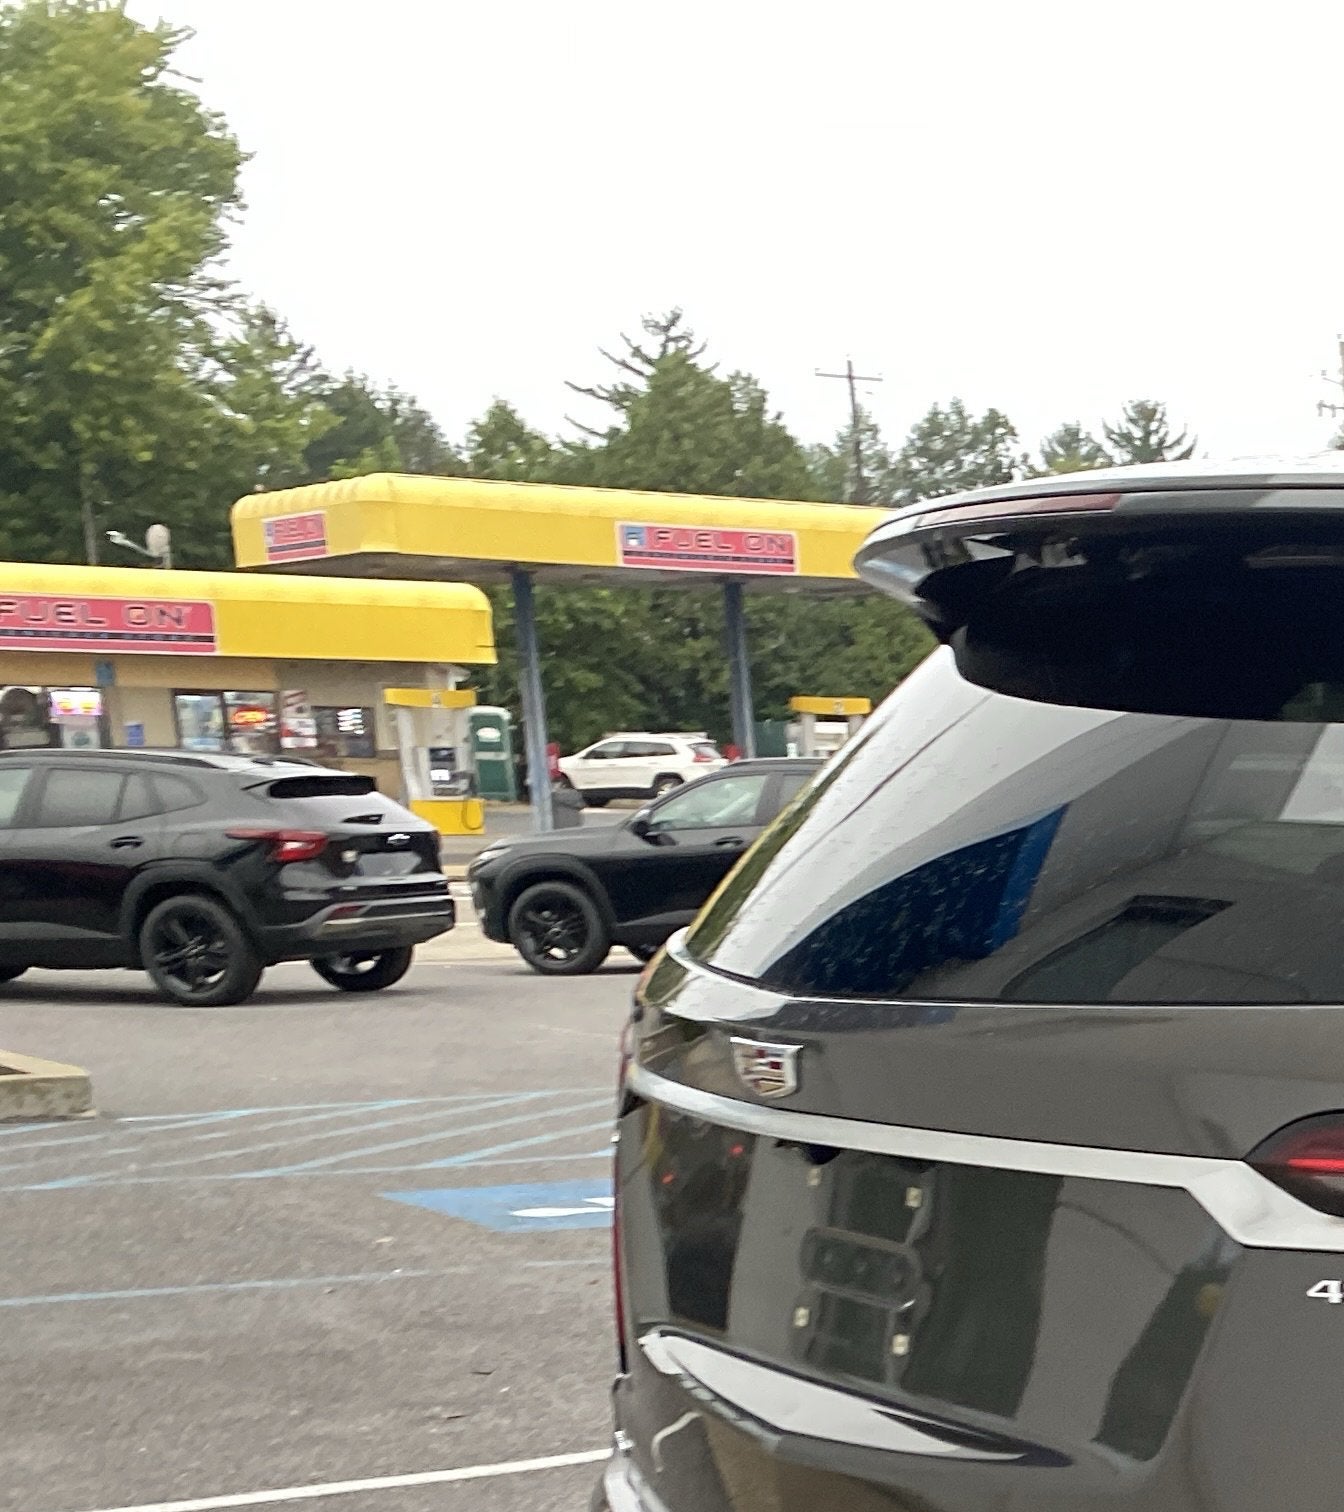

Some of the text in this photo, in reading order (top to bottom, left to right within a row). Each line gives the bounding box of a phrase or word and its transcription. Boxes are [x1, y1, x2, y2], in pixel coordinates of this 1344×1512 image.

[654, 528, 788, 553] FUEL ON
[124, 604, 189, 629] ON
